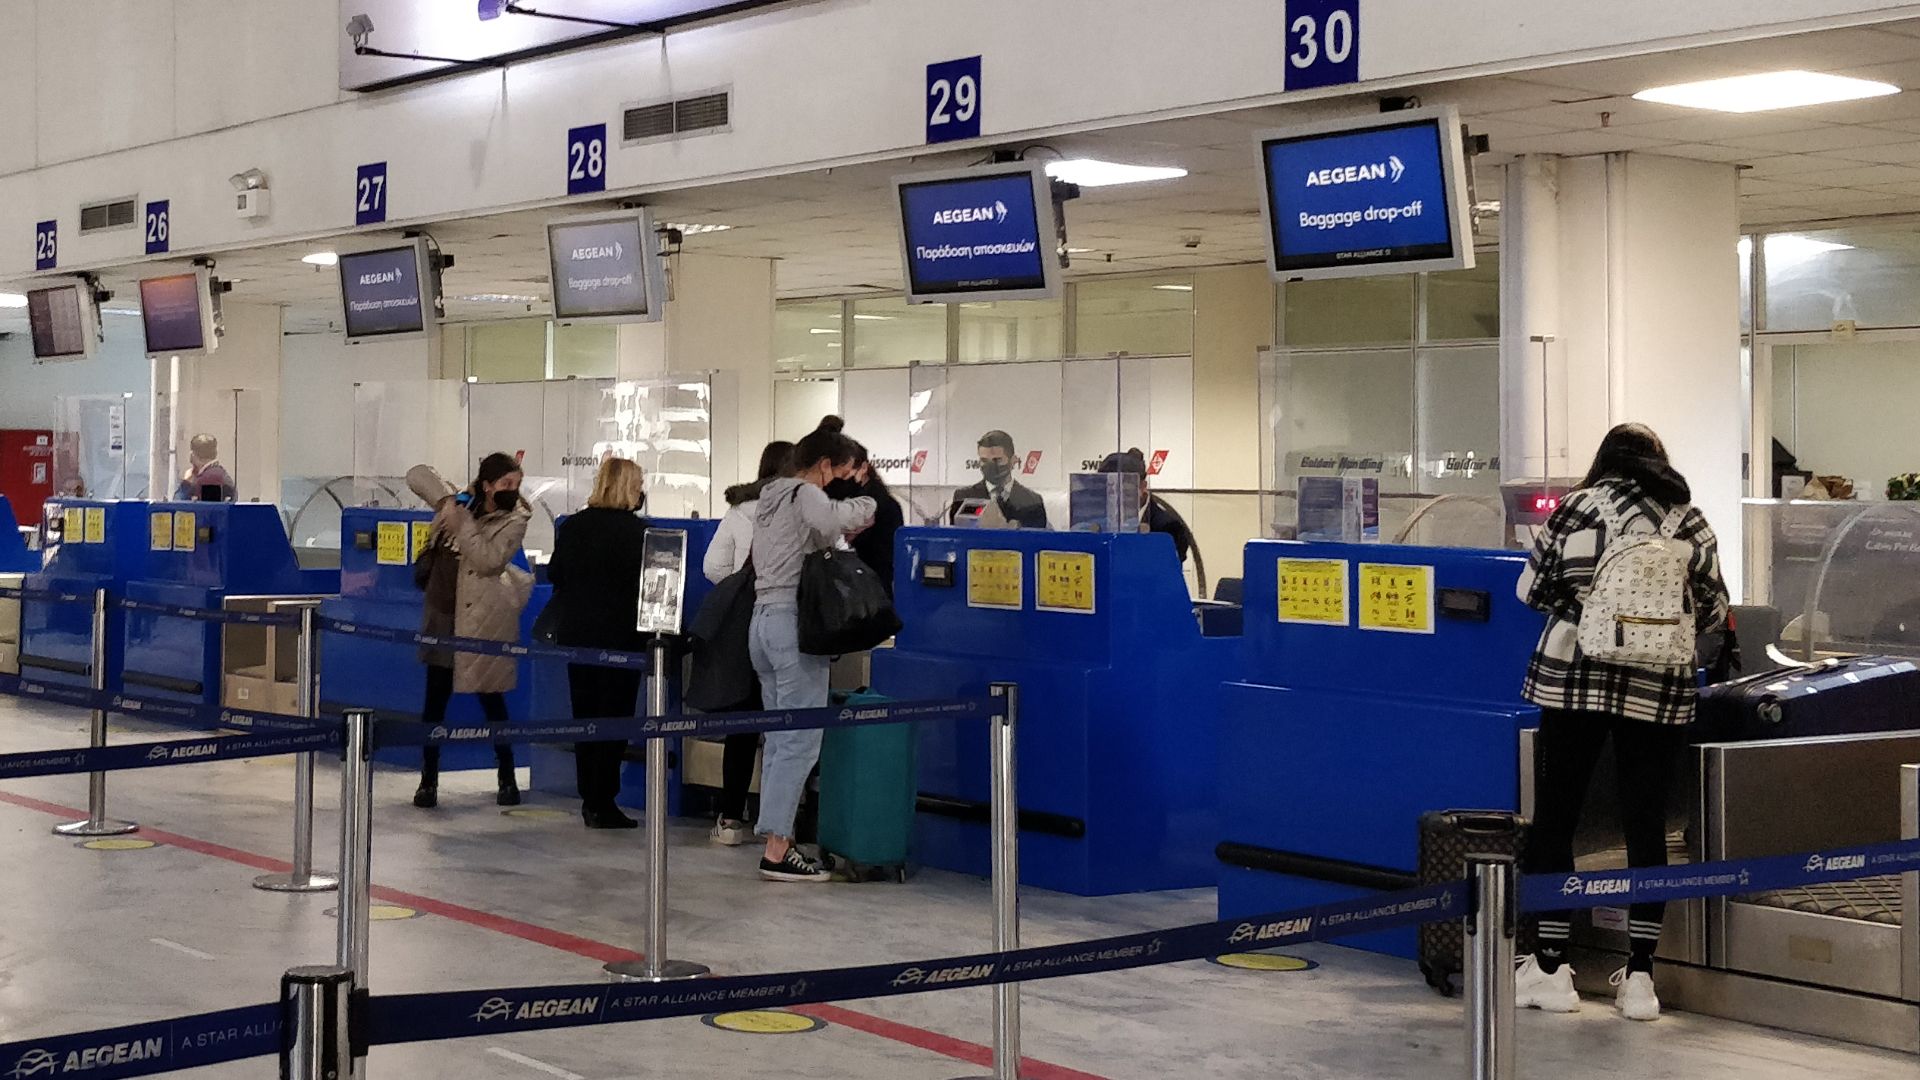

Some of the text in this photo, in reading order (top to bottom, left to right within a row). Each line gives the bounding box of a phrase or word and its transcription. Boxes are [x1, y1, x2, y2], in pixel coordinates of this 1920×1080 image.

[1290, 10, 1354, 70] 30
[929, 75, 977, 126] 29
[570, 138, 603, 181] 28
[1306, 162, 1386, 188] AEGEAN
[358, 175, 385, 212] 27
[147, 211, 168, 243] 26
[933, 206, 994, 225] AEGEAN
[1299, 200, 1423, 231] Baggage drop-off
[37, 230, 56, 260] 25
[571, 246, 614, 261] AEGEAN
[916, 238, 1036, 262] Παράδοση αποσκευών
[360, 271, 395, 285] AEGEAN
[1301, 456, 1337, 470] Goldair
[449, 727, 491, 739] AEGEAN
[660, 720, 697, 732] AEGEAN
[170, 743, 218, 759] AEGEAN
[1825, 853, 1866, 871] AEGEAN
[1584, 878, 1632, 895] AEGEAN
[1256, 897, 1438, 940] AEGEAN A STAR ALLIANCE MEMBER
[925, 944, 1144, 984] AEGEAN A STAR ALLIANCE MEMBER
[515, 984, 786, 1020] AEGEAN A STAR ALLIANCE MEMBER
[62, 1036, 163, 1073] AEGEAN
[181, 1036, 192, 1050] A
[196, 1027, 239, 1048] STAR
